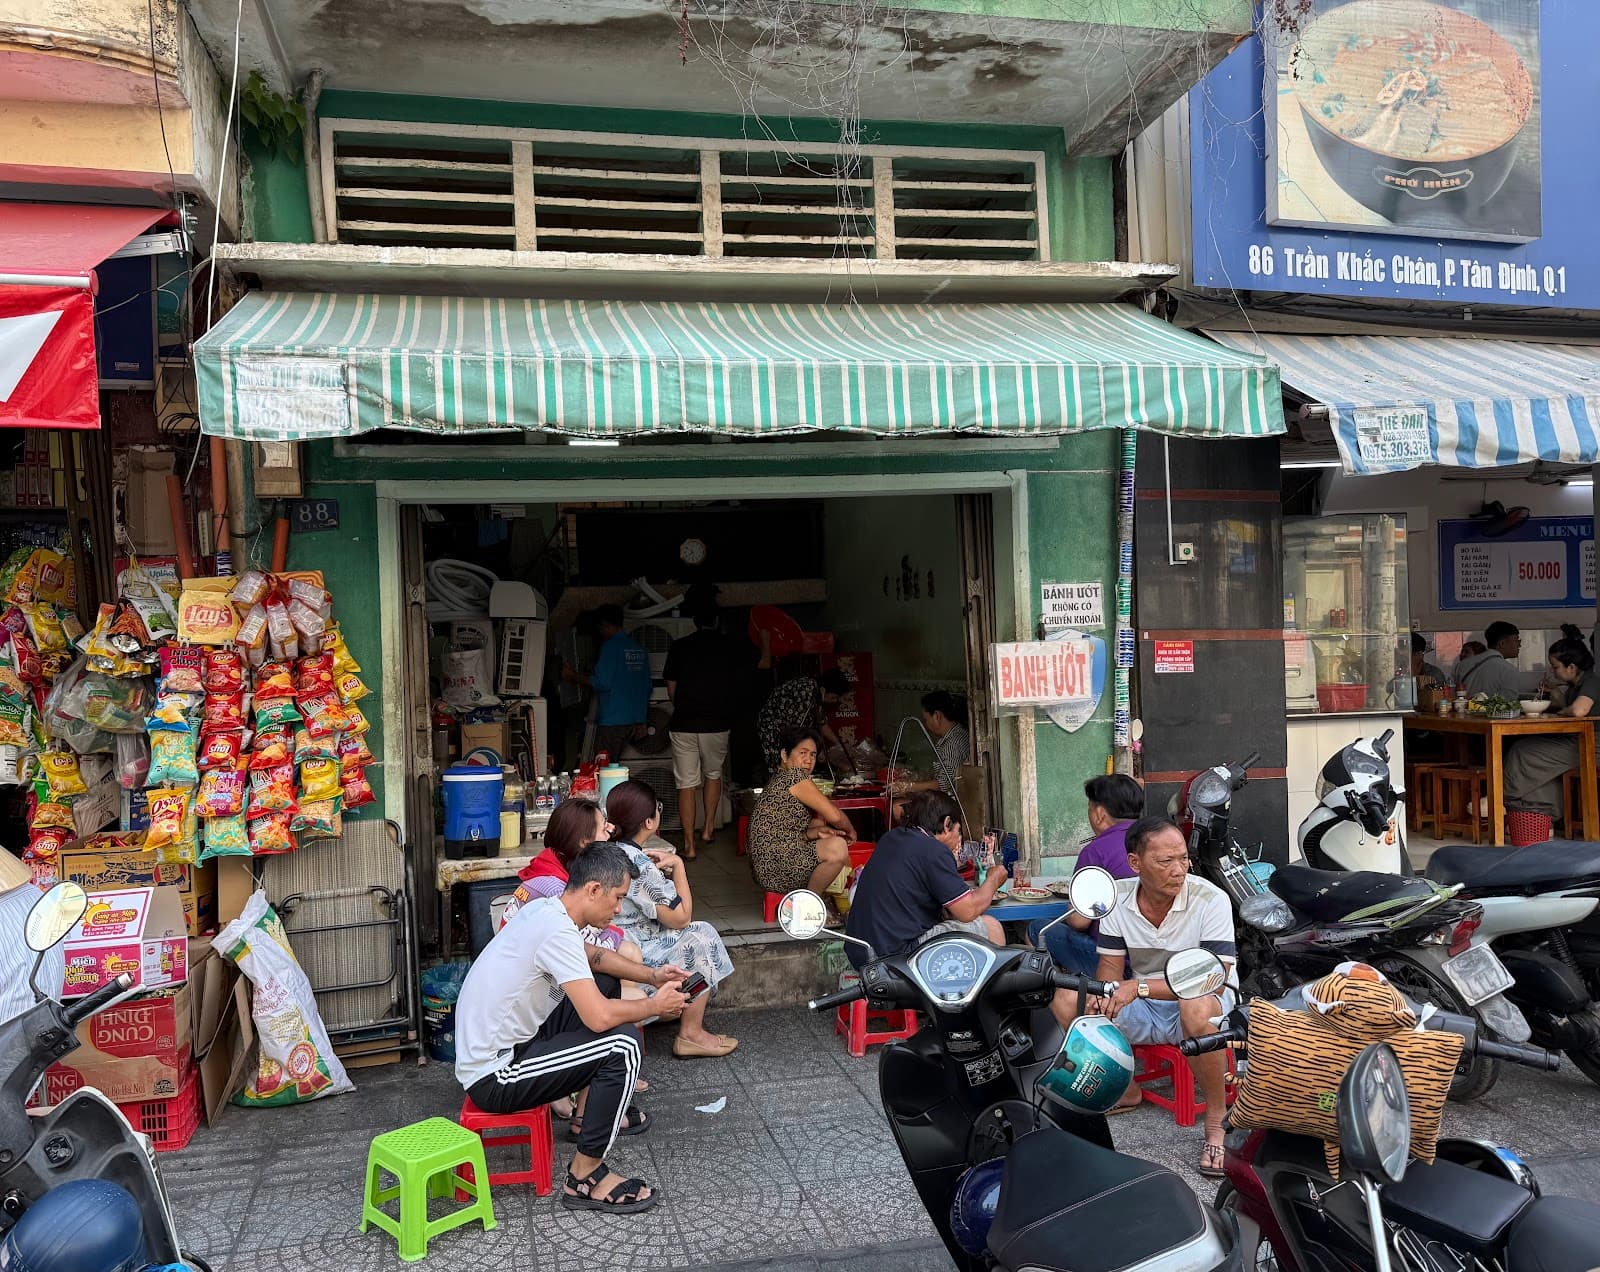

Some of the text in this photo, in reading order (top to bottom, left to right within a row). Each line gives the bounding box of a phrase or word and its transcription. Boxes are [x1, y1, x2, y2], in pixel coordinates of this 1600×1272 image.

[1248, 245, 1273, 275] 86
[1284, 246, 1329, 279] Trần
[1337, 248, 1386, 283] Khắc
[1392, 254, 1440, 288] Chân,
[1460, 260, 1492, 289] Tân
[1498, 262, 1541, 295] Định,
[1543, 266, 1566, 296] Q.1
[299, 503, 328, 523] 88
[1540, 525, 1592, 537] MENU
[1519, 561, 1561, 580] 50.000
[1043, 585, 1099, 600] BÁNH ƯỚT
[188, 604, 230, 626] Lay's
[1052, 600, 1092, 612] KHÔNG CÓ
[1044, 612, 1101, 625] CHUYỂN KHOẢN
[169, 648, 198, 657] INDO
[1001, 644, 1048, 698] BÁNH
[1052, 642, 1086, 697] ƯỚT
[101, 1008, 151, 1026] ĐÌNH
[98, 1025, 154, 1044] CUNG
